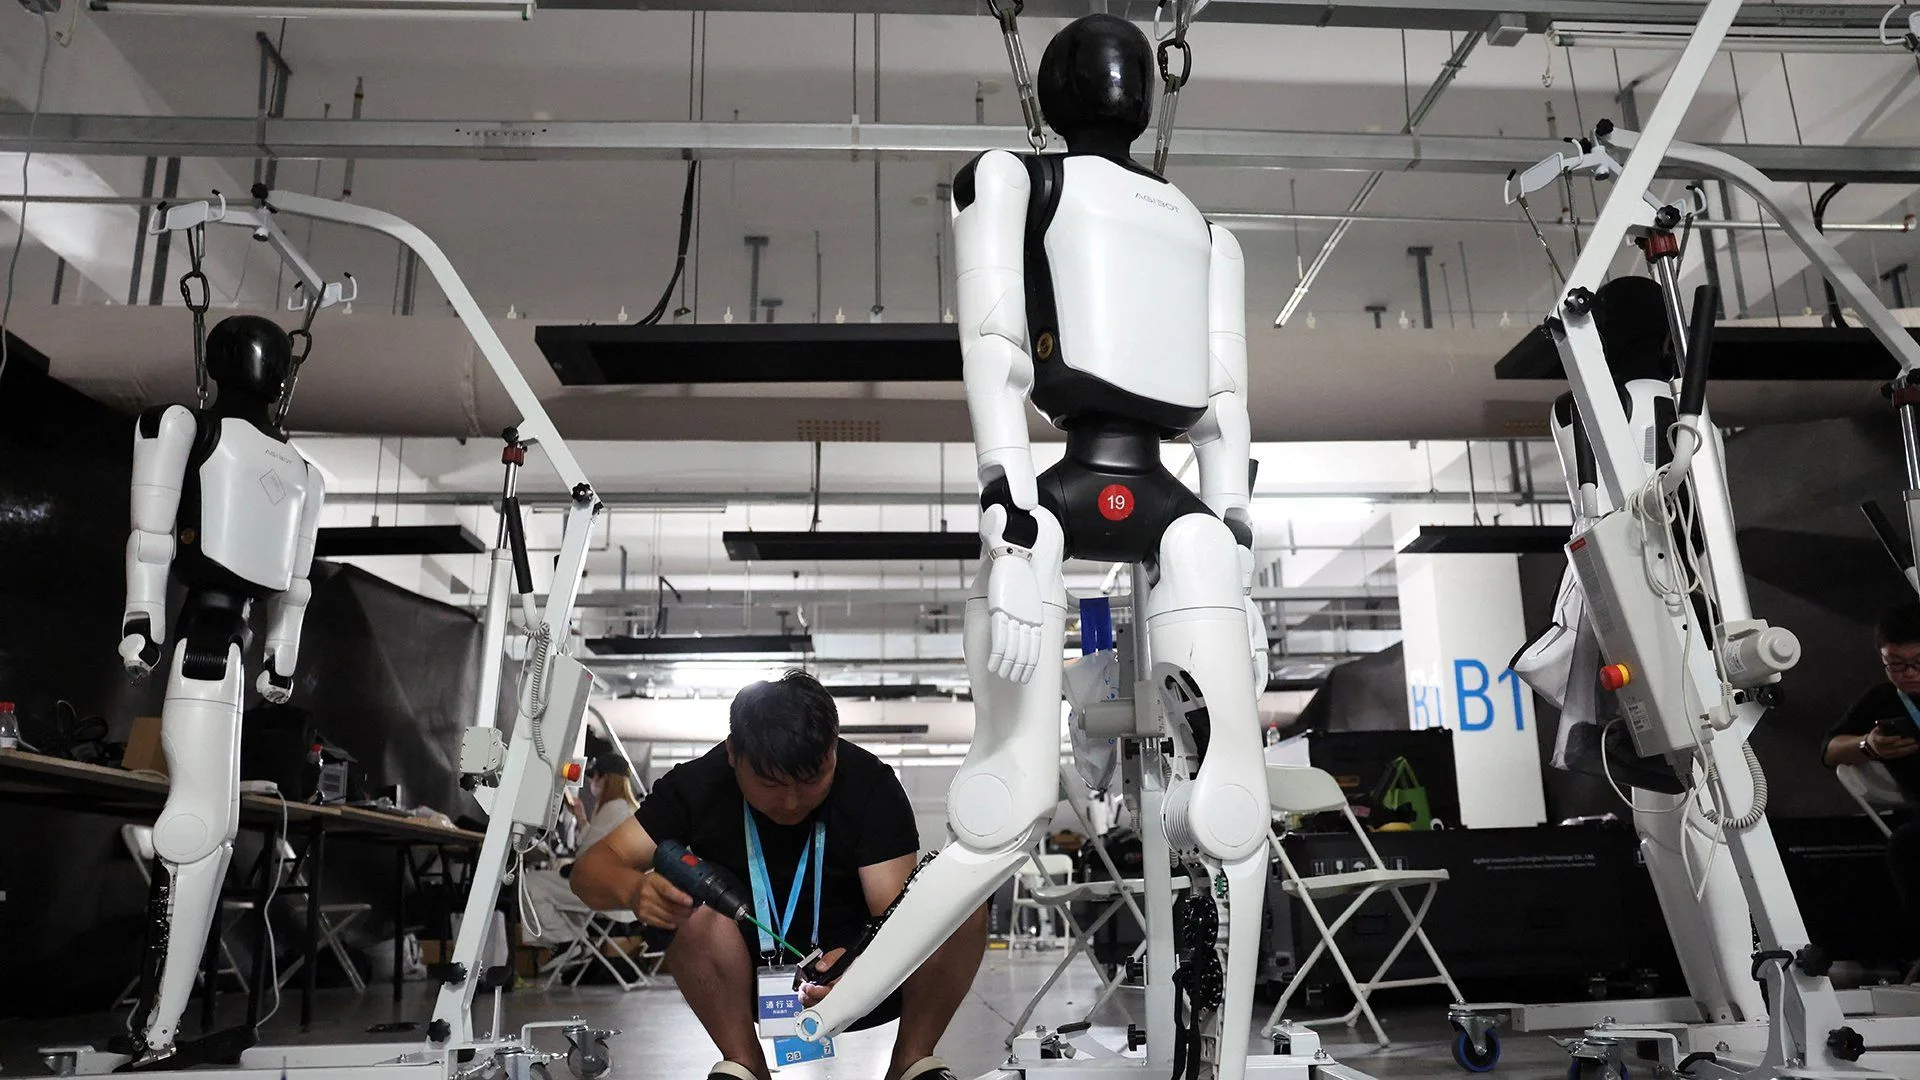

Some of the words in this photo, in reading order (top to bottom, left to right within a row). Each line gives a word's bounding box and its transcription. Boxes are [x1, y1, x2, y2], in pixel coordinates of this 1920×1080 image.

[1107, 494, 1125, 510] 19
[1454, 659, 1524, 731] B1
[765, 999, 794, 1009] 通行证
